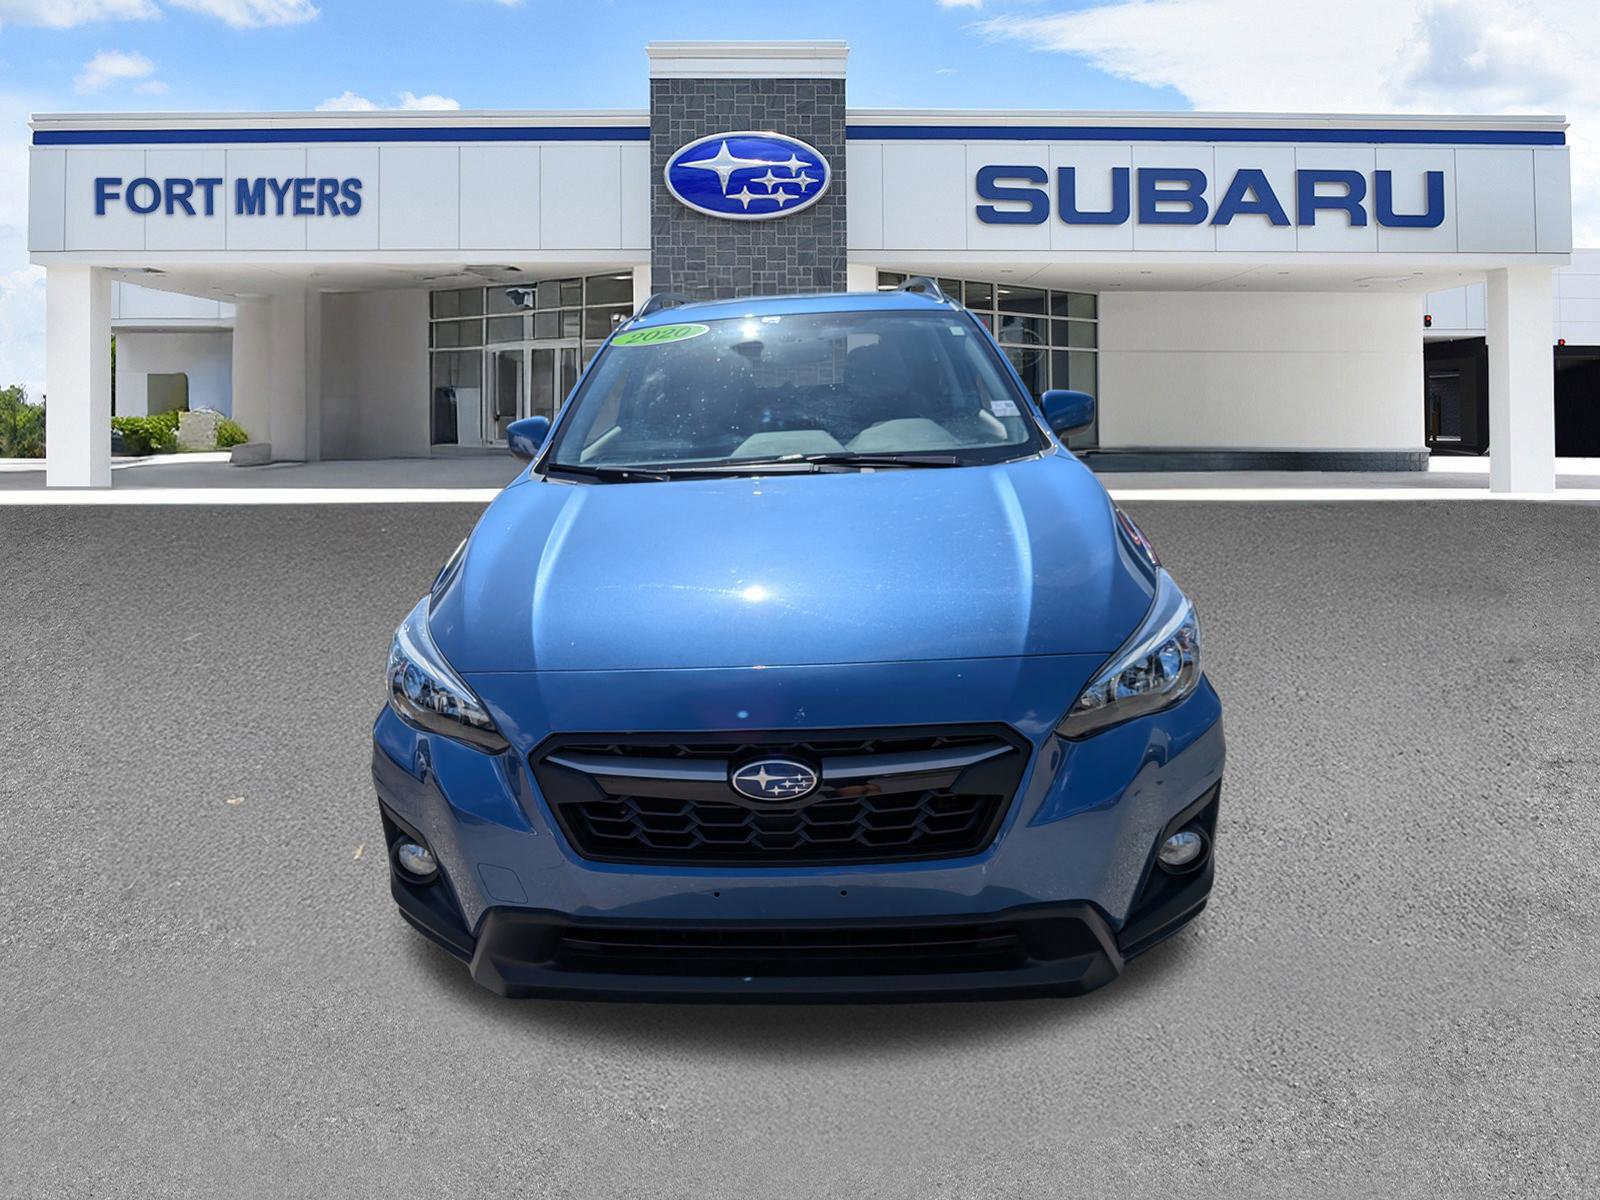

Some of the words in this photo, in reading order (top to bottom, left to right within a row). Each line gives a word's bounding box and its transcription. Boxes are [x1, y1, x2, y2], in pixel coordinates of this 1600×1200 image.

[95, 178, 223, 216] FORT
[235, 178, 362, 216] MYERS
[976, 165, 1445, 228] SUBARU
[625, 326, 692, 344] 2020
